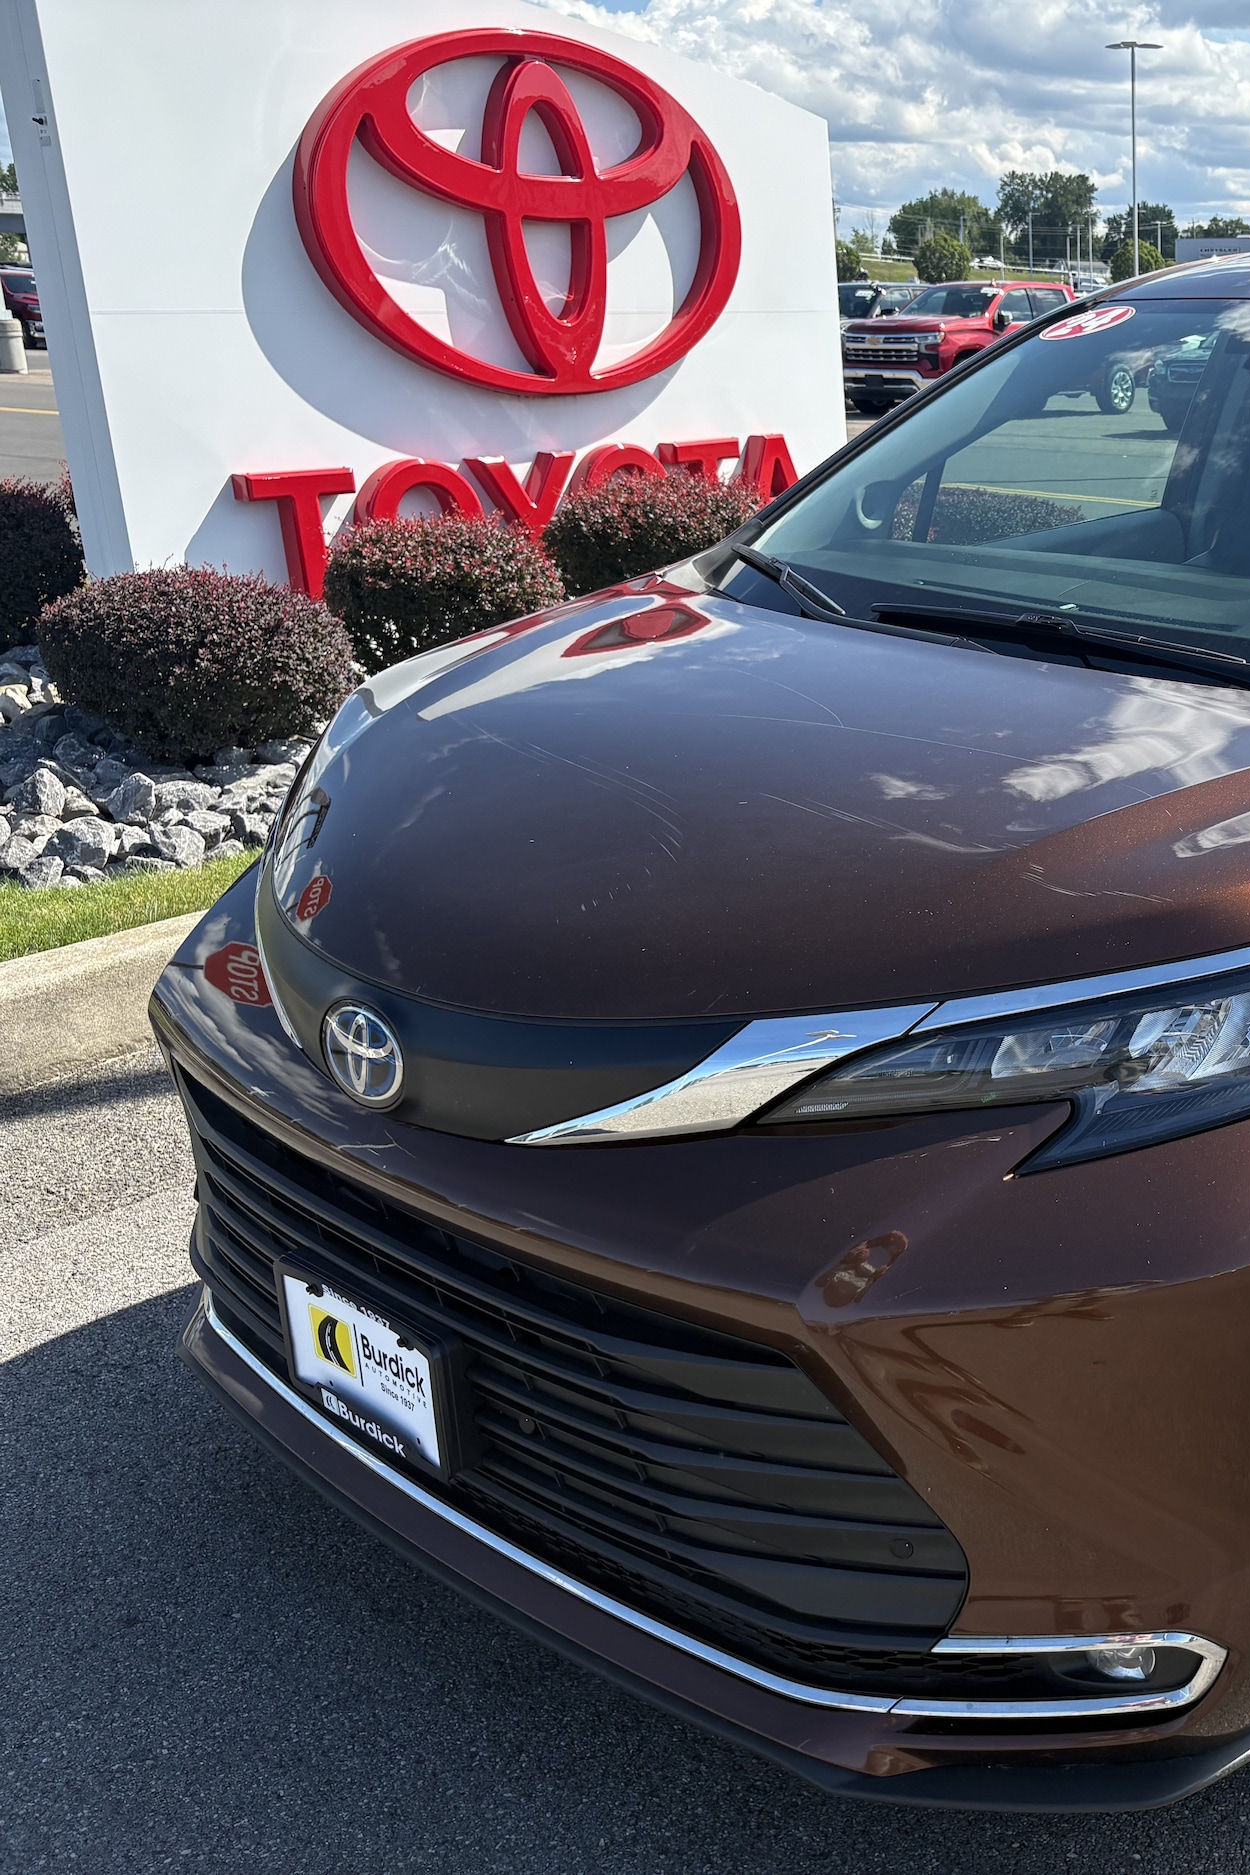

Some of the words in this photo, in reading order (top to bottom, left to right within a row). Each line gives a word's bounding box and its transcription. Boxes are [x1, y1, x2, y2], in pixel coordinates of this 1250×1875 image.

[360, 1333, 426, 1397] Burdick
[365, 1363, 427, 1409] AUTOMOTIVE
[380, 1382, 399, 1401] Since
[400, 1396, 415, 1411] 1937
[337, 1400, 407, 1458] Burdick
